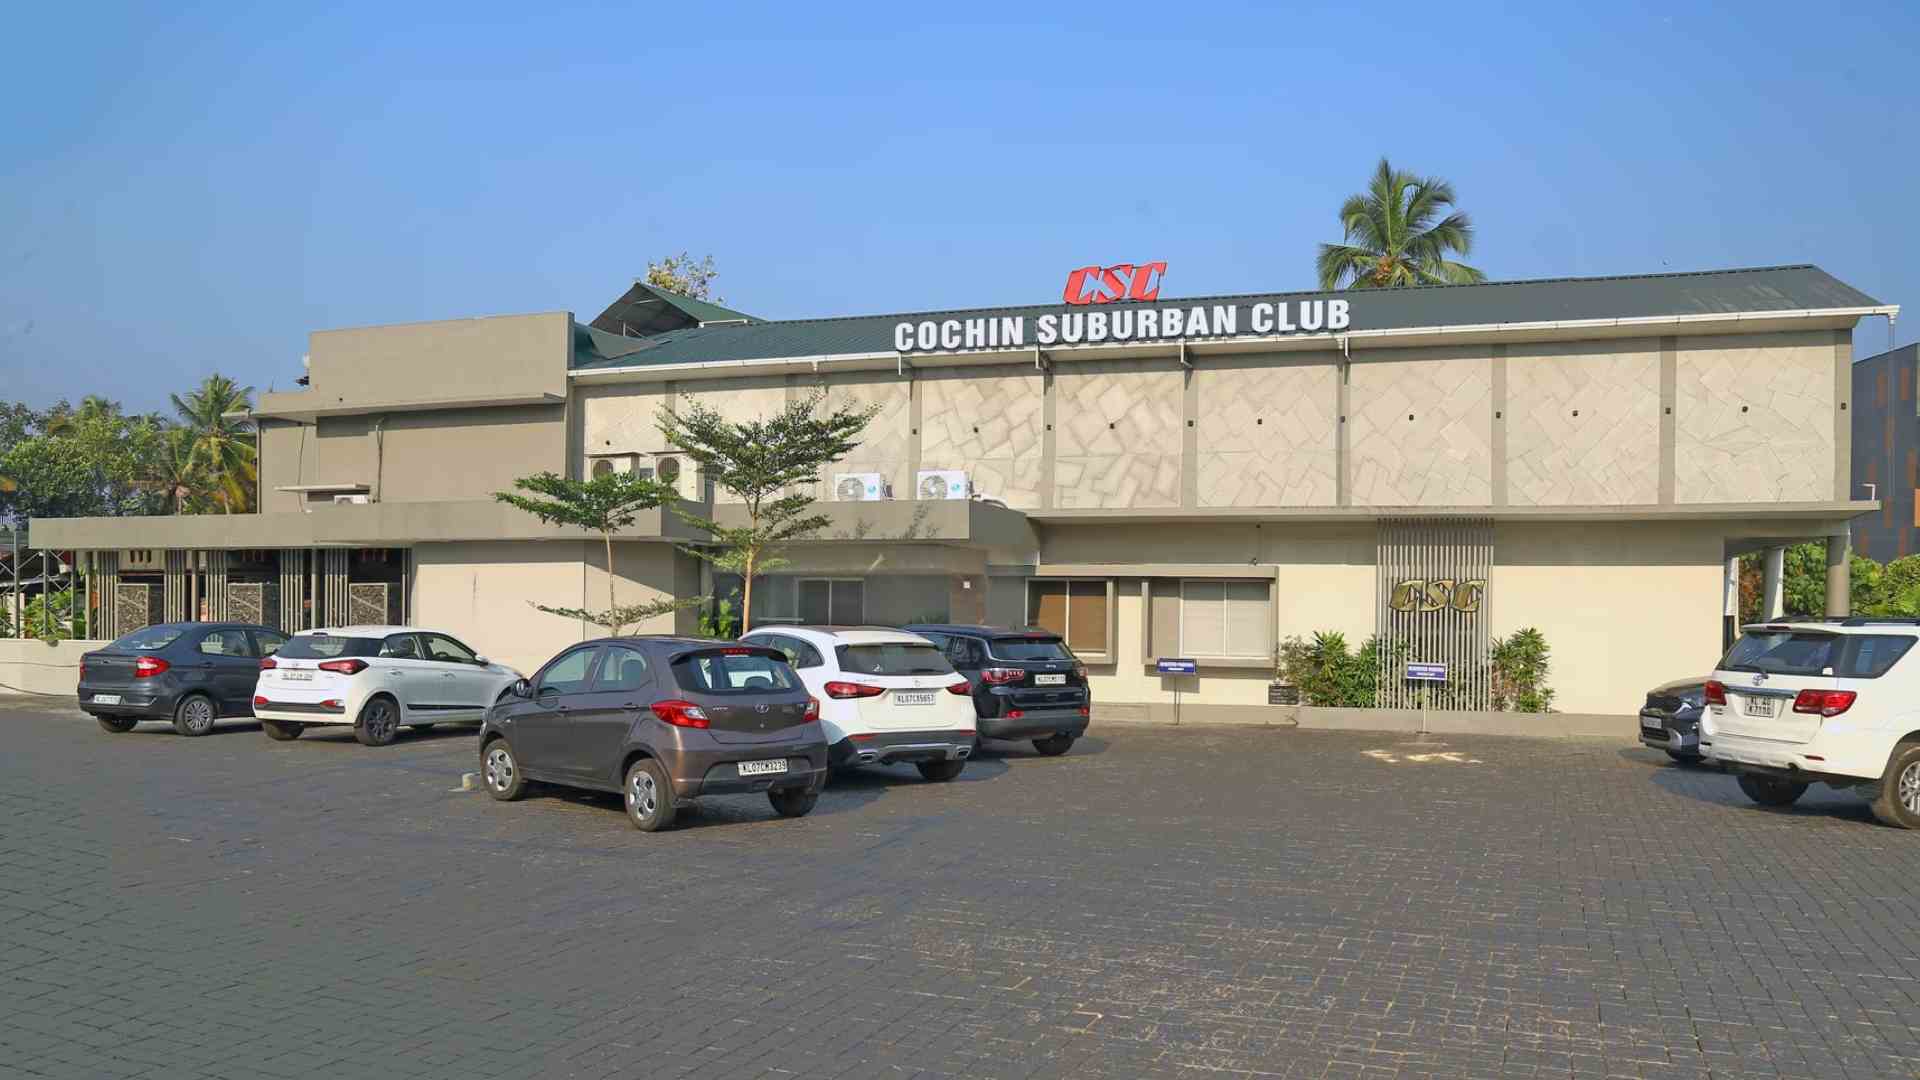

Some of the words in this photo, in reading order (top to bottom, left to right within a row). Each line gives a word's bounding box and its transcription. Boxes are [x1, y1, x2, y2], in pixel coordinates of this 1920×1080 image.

[1063, 261, 1167, 305] CSC
[894, 316, 1024, 352] COCHIN
[1036, 304, 1237, 345] SUBURBAN
[1251, 298, 1351, 332] CLUB
[1390, 579, 1486, 612] CSC
